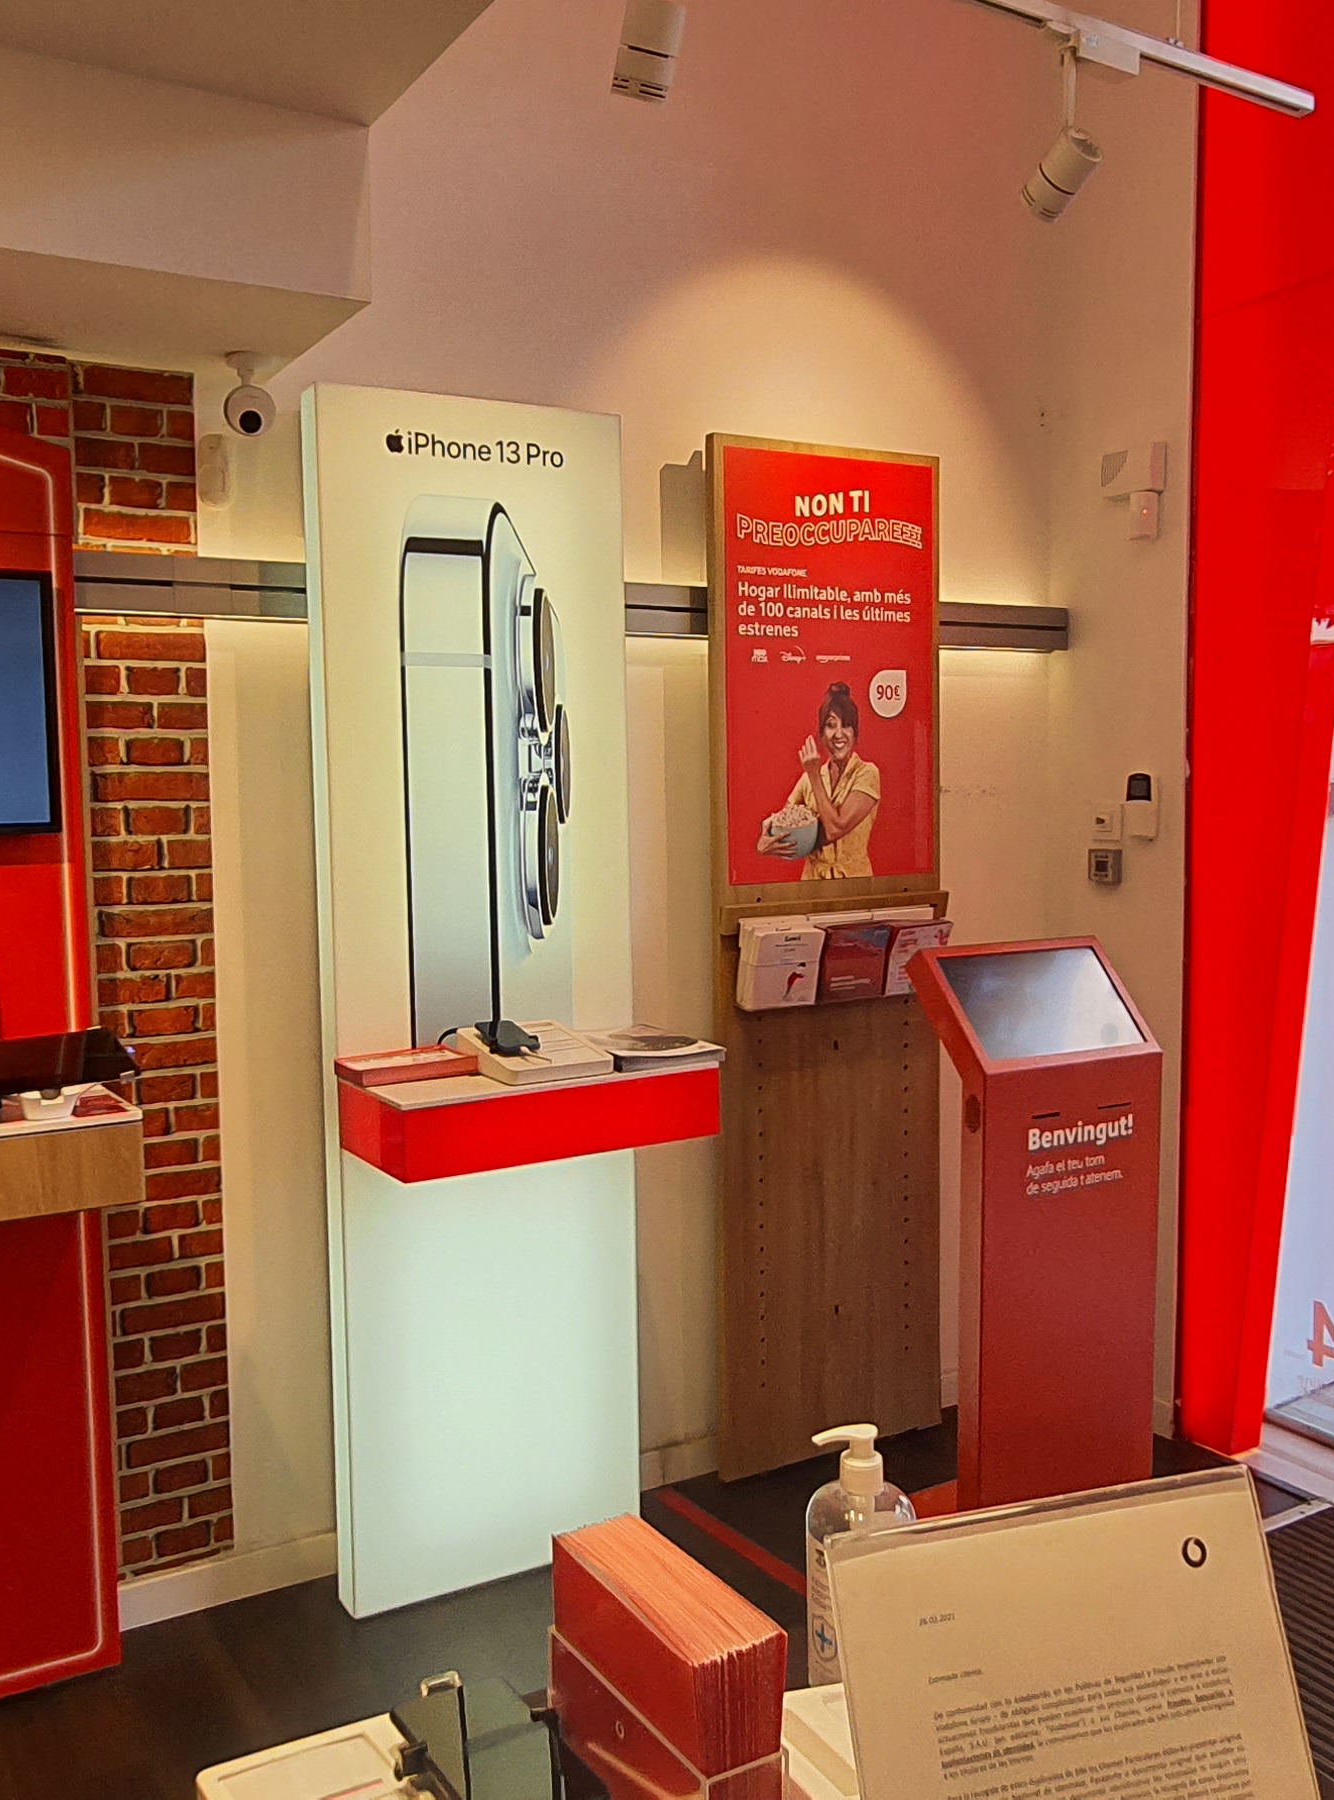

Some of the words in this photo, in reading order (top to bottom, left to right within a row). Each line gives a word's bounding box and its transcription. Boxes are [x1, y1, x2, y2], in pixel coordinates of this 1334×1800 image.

[408, 431, 492, 462] iPhone
[495, 440, 521, 464] 13
[527, 442, 565, 468] Pro
[795, 492, 844, 517] NON
[849, 490, 870, 513] TI
[767, 567, 808, 577] VODAFONE
[738, 581, 781, 601] Hogar
[783, 583, 851, 604] Ilimitable,
[853, 588, 880, 603] amb
[884, 589, 912, 605] més
[738, 601, 756, 616] de
[759, 601, 784, 618] 100
[786, 604, 831, 620] canals
[833, 605, 838, 620] i
[840, 605, 860, 621] les
[862, 605, 912, 622] últimes
[738, 621, 799, 637] estrenes
[876, 684, 901, 700] 90€
[1027, 1113, 1134, 1151] Benvingut!
[1026, 1160, 1055, 1179] Agafa
[1055, 1160, 1066, 1172] el
[1067, 1159, 1084, 1171] teu
[1026, 1182, 1040, 1195] de
[1041, 1175, 1078, 1194] seguida
